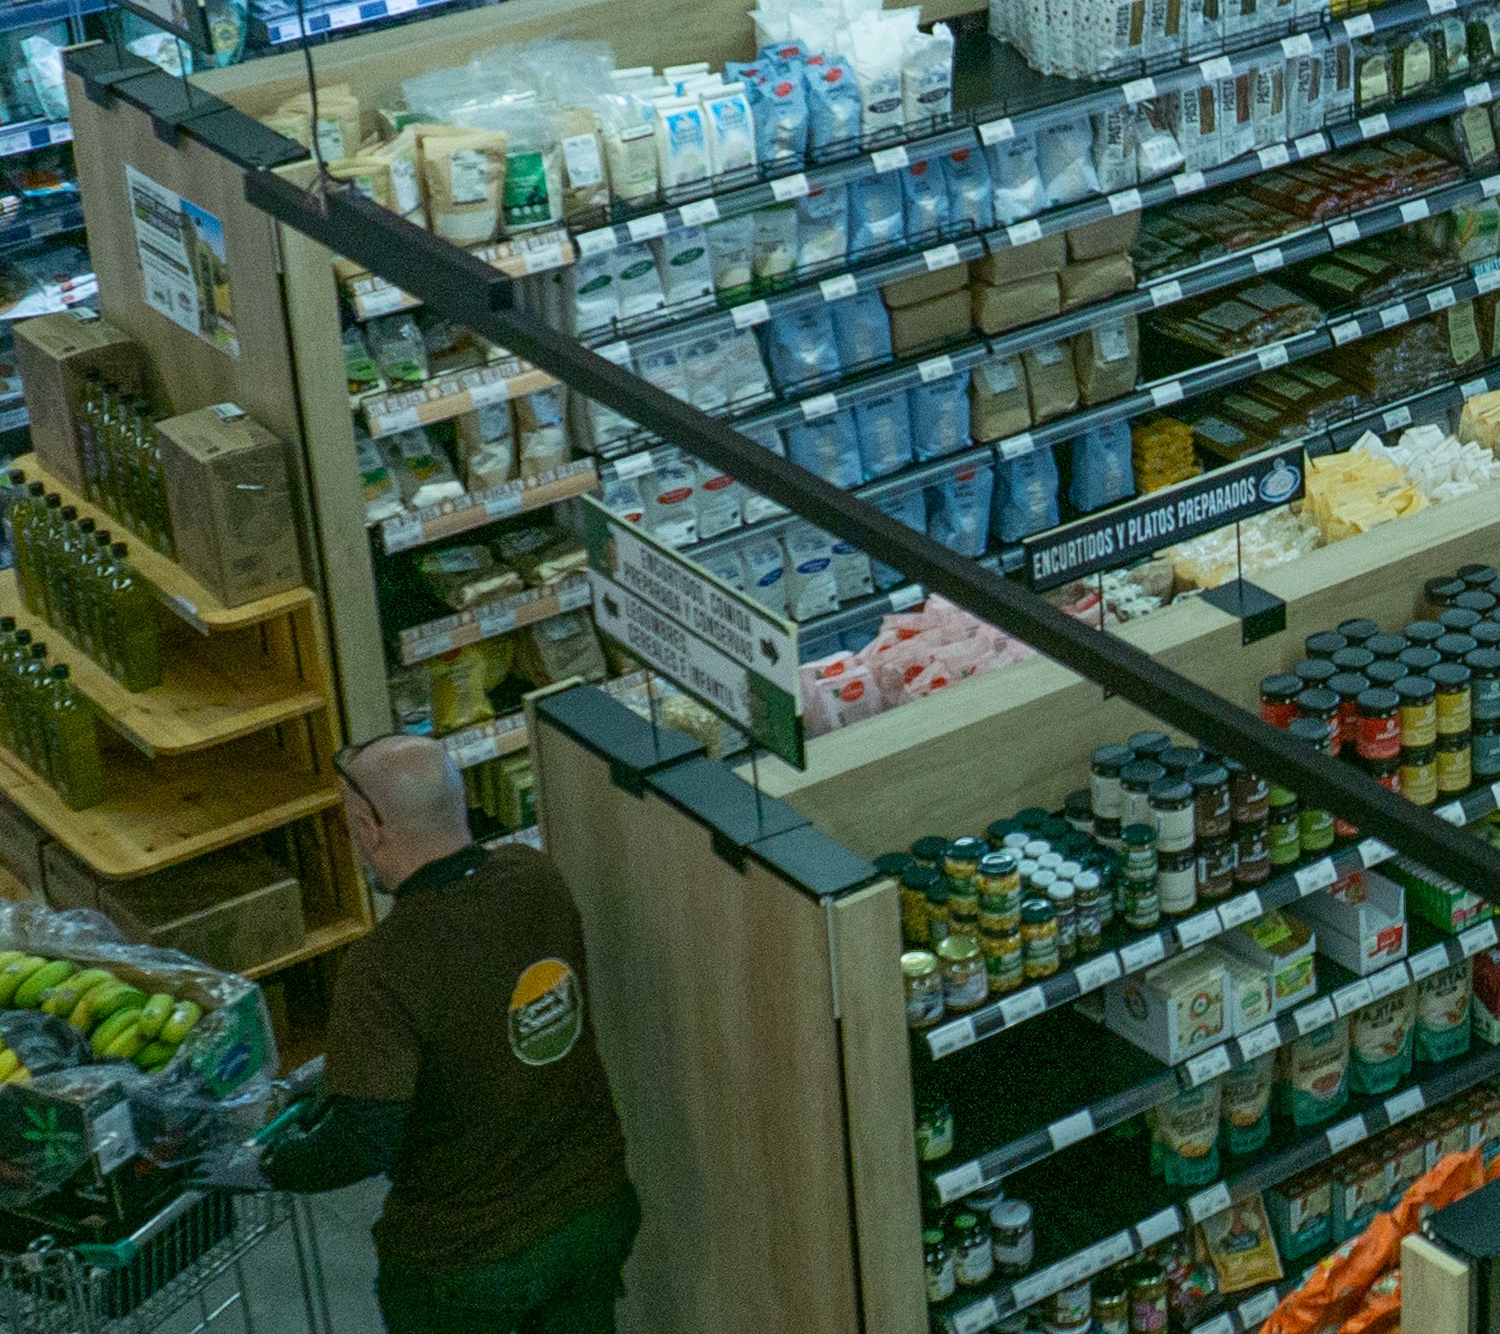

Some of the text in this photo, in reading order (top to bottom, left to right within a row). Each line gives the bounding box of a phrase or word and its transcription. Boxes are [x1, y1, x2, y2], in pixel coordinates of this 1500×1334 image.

[1032, 476, 1256, 581] ENCURTIDOS Y PLATOS PREPARADOS
[623, 562, 681, 613] PREPARADA
[709, 593, 752, 634] COMIDA
